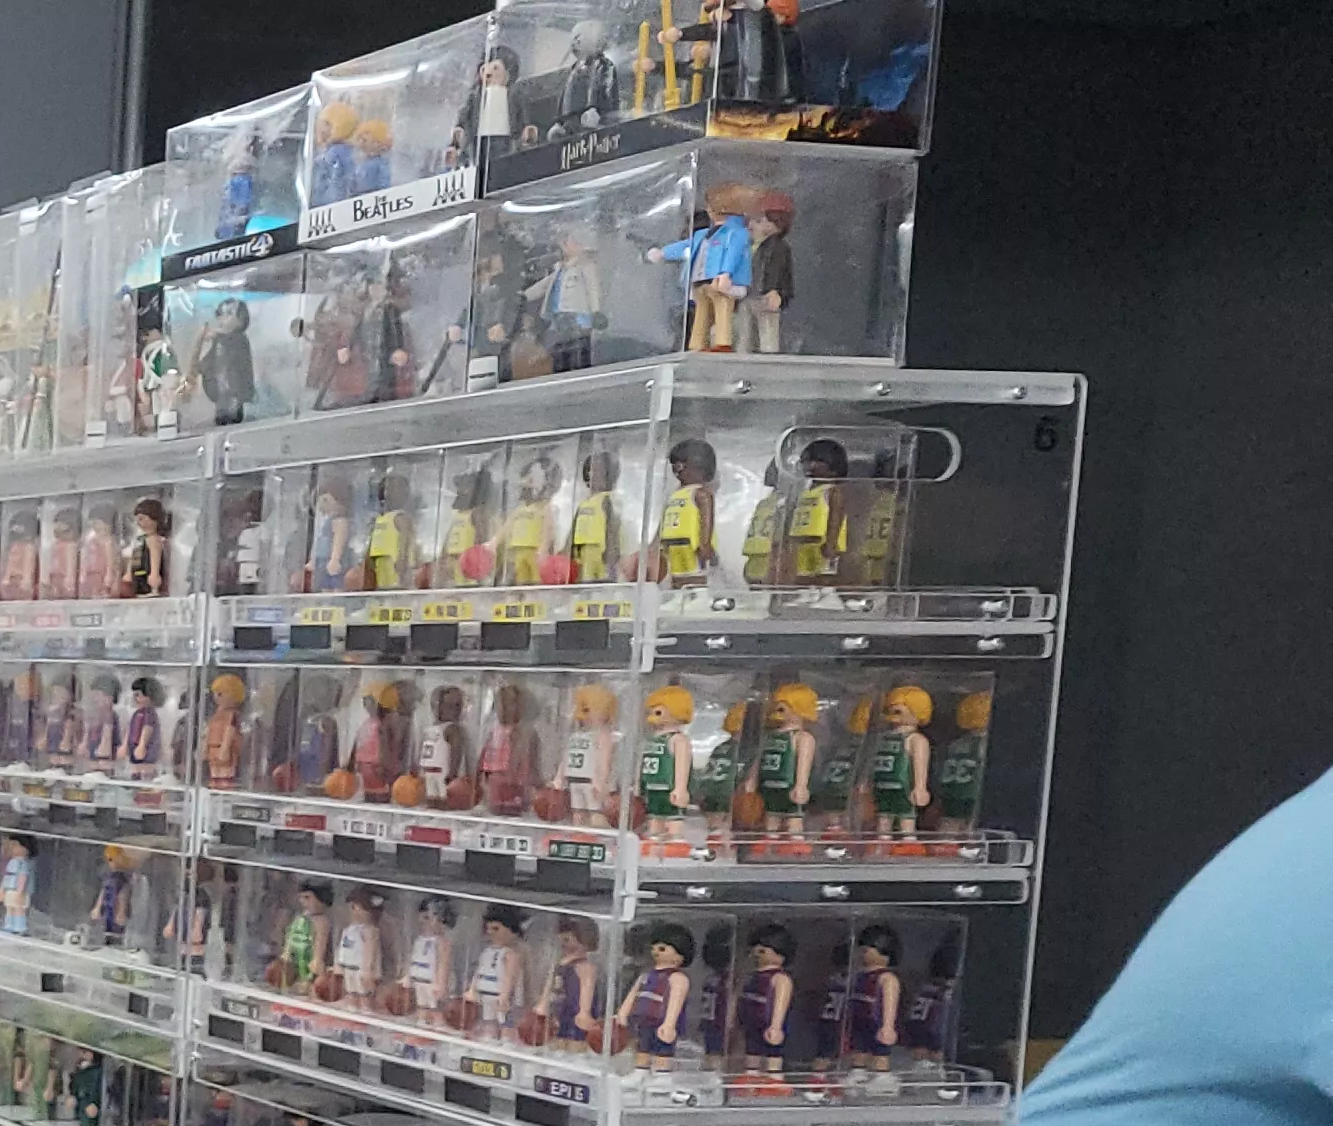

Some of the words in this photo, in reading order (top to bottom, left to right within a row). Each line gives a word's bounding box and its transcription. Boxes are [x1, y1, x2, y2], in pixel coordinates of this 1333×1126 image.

[353, 195, 414, 222] BEATLES
[184, 241, 253, 271] FANTASTIC
[251, 233, 274, 258] 4
[549, 1081, 573, 1098] EPI
